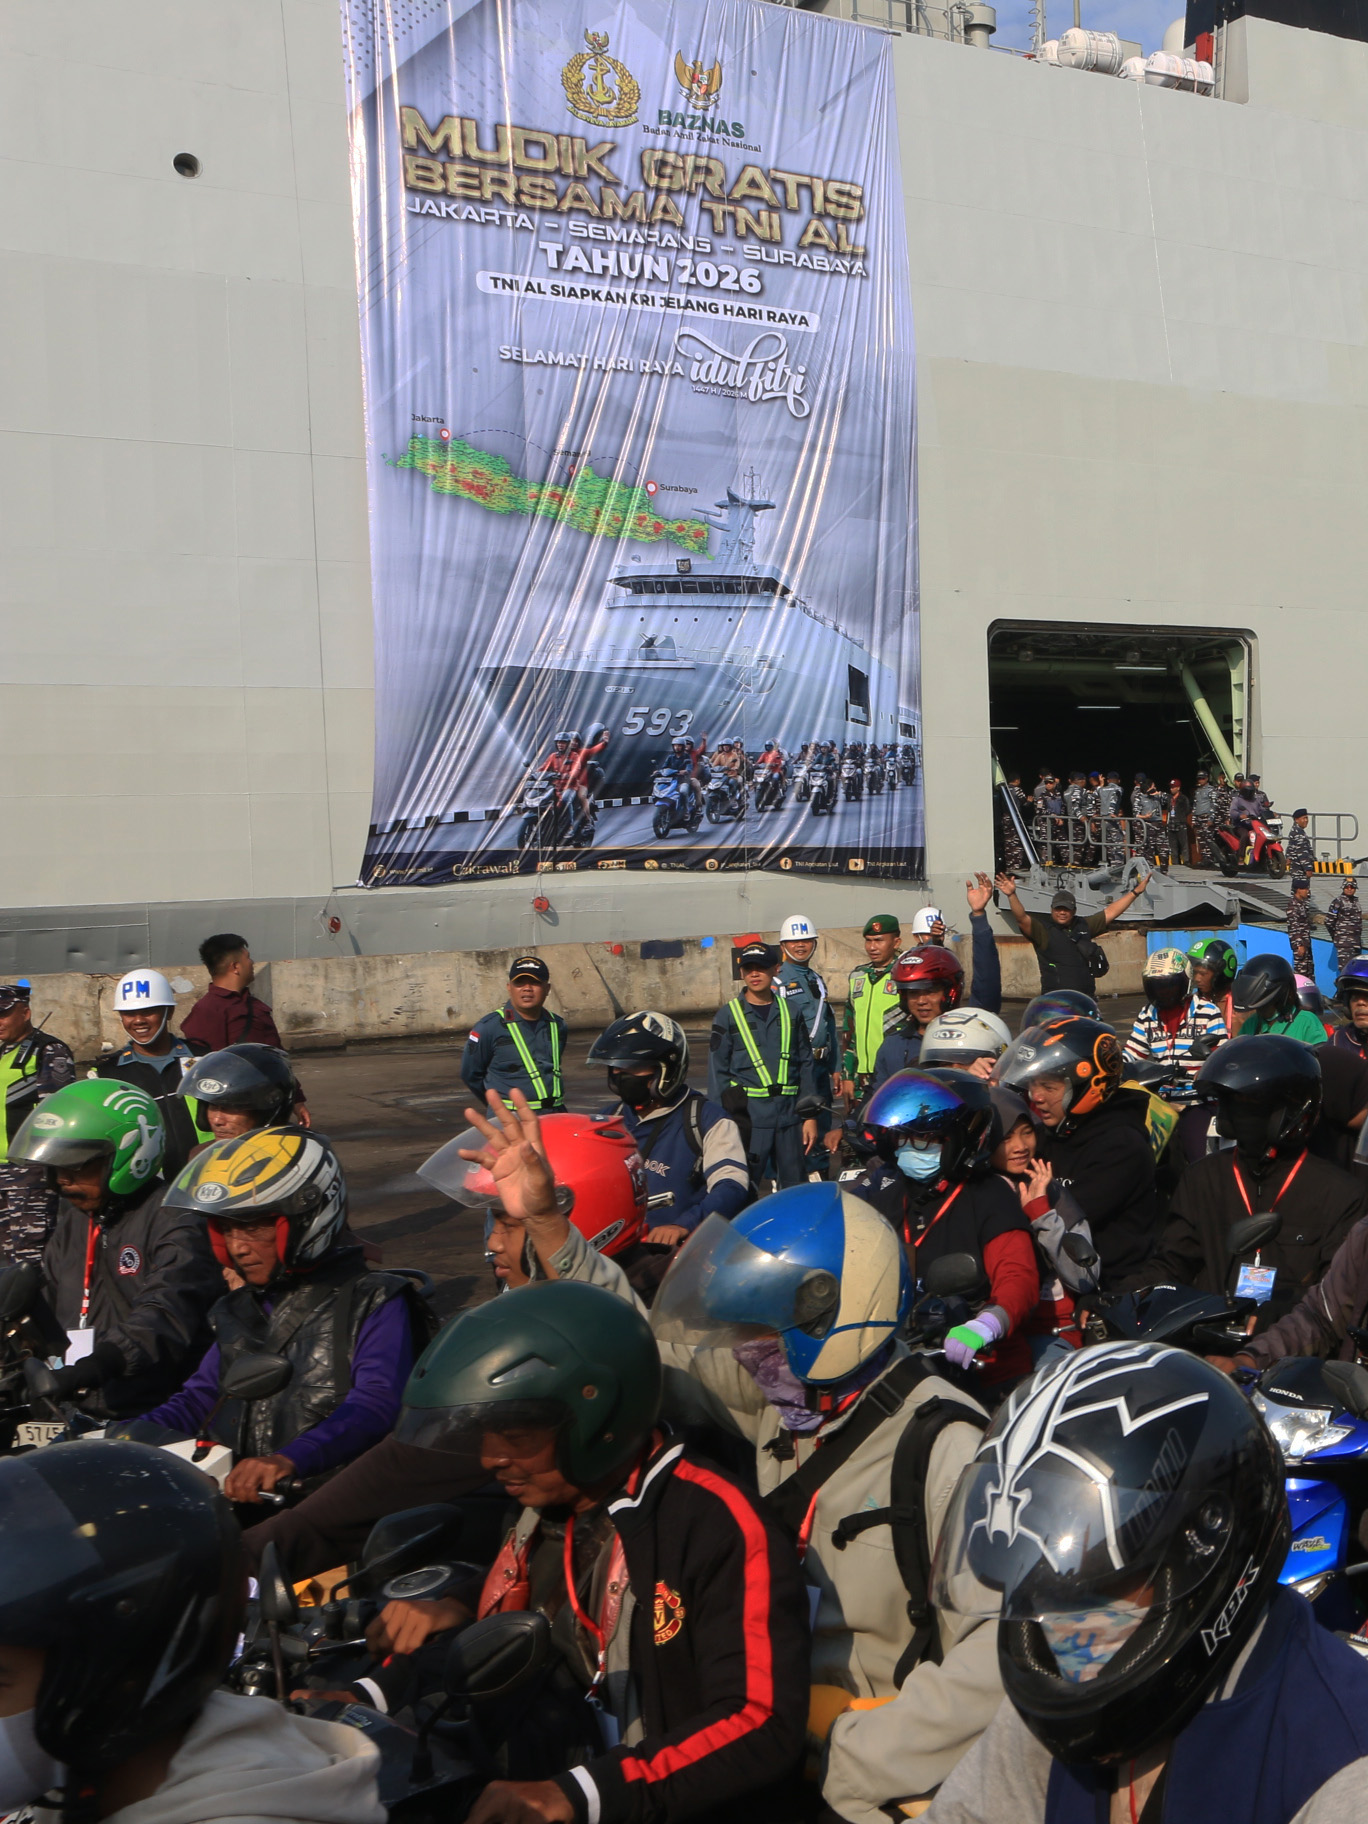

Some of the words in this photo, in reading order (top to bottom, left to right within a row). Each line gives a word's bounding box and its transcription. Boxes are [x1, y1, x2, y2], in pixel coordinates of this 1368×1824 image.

[643, 125, 671, 137] Badan
[673, 130, 694, 141] Amil
[697, 132, 720, 144] Zakat
[722, 137, 762, 152] Nasional
[658, 109, 745, 138] BAZNAS
[401, 106, 622, 183] MUDIK
[641, 149, 864, 220] GRATIS
[404, 154, 684, 228] BERSAMA
[702, 200, 781, 243] TNI
[799, 218, 866, 255] AL
[406, 197, 535, 230] JAKARTA
[568, 220, 711, 253] SEMARANG
[743, 244, 867, 277] SURABAYA
[539, 241, 669, 283] TAHUN
[676, 258, 762, 294] 2026
[489, 276, 519, 292] TNI
[524, 280, 546, 295] AL
[550, 285, 626, 305] SIAPKAN
[629, 292, 655, 308] KRI
[660, 296, 720, 314] JELANG
[723, 305, 763, 321] HARI
[767, 312, 810, 328] RAYA
[499, 345, 589, 369] SELAMAT
[593, 356, 634, 373] HARI
[639, 359, 685, 377] RAYA
[411, 414, 445, 425] Jakarta
[660, 483, 698, 495] Surabaya
[621, 706, 695, 737] 593
[791, 922, 808, 936] PM
[122, 980, 151, 1001] PM
[1269, 1387, 1304, 1402] HONDA
